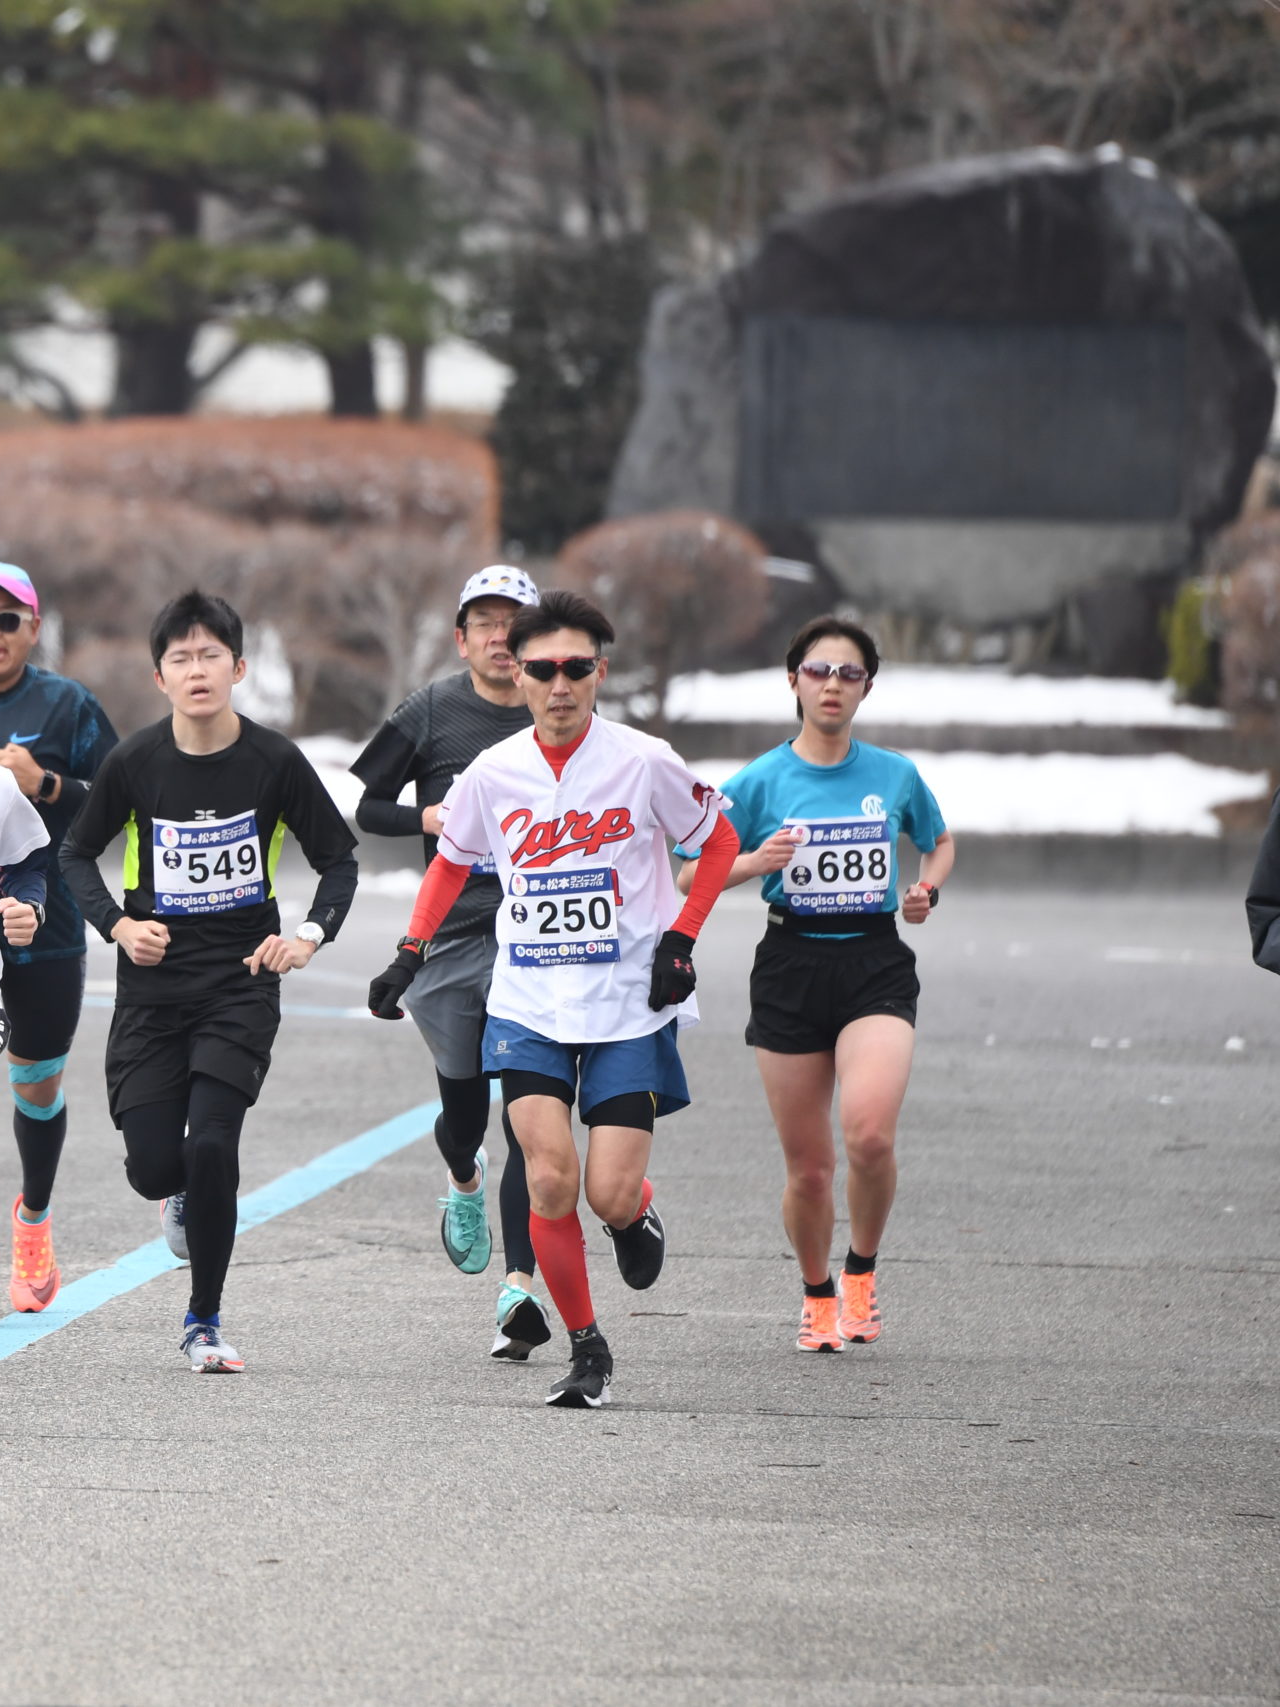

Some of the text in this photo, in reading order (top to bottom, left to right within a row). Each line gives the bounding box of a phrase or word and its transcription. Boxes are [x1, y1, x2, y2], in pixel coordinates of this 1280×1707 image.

[500, 808, 635, 868] Carp
[188, 844, 256, 884] 549
[818, 848, 887, 883] 688
[207, 891, 233, 904] Life
[234, 885, 259, 898] Site
[529, 877, 570, 891] 春の松本
[536, 896, 612, 934] 250
[558, 943, 585, 957] Life
[585, 941, 613, 954] Site
